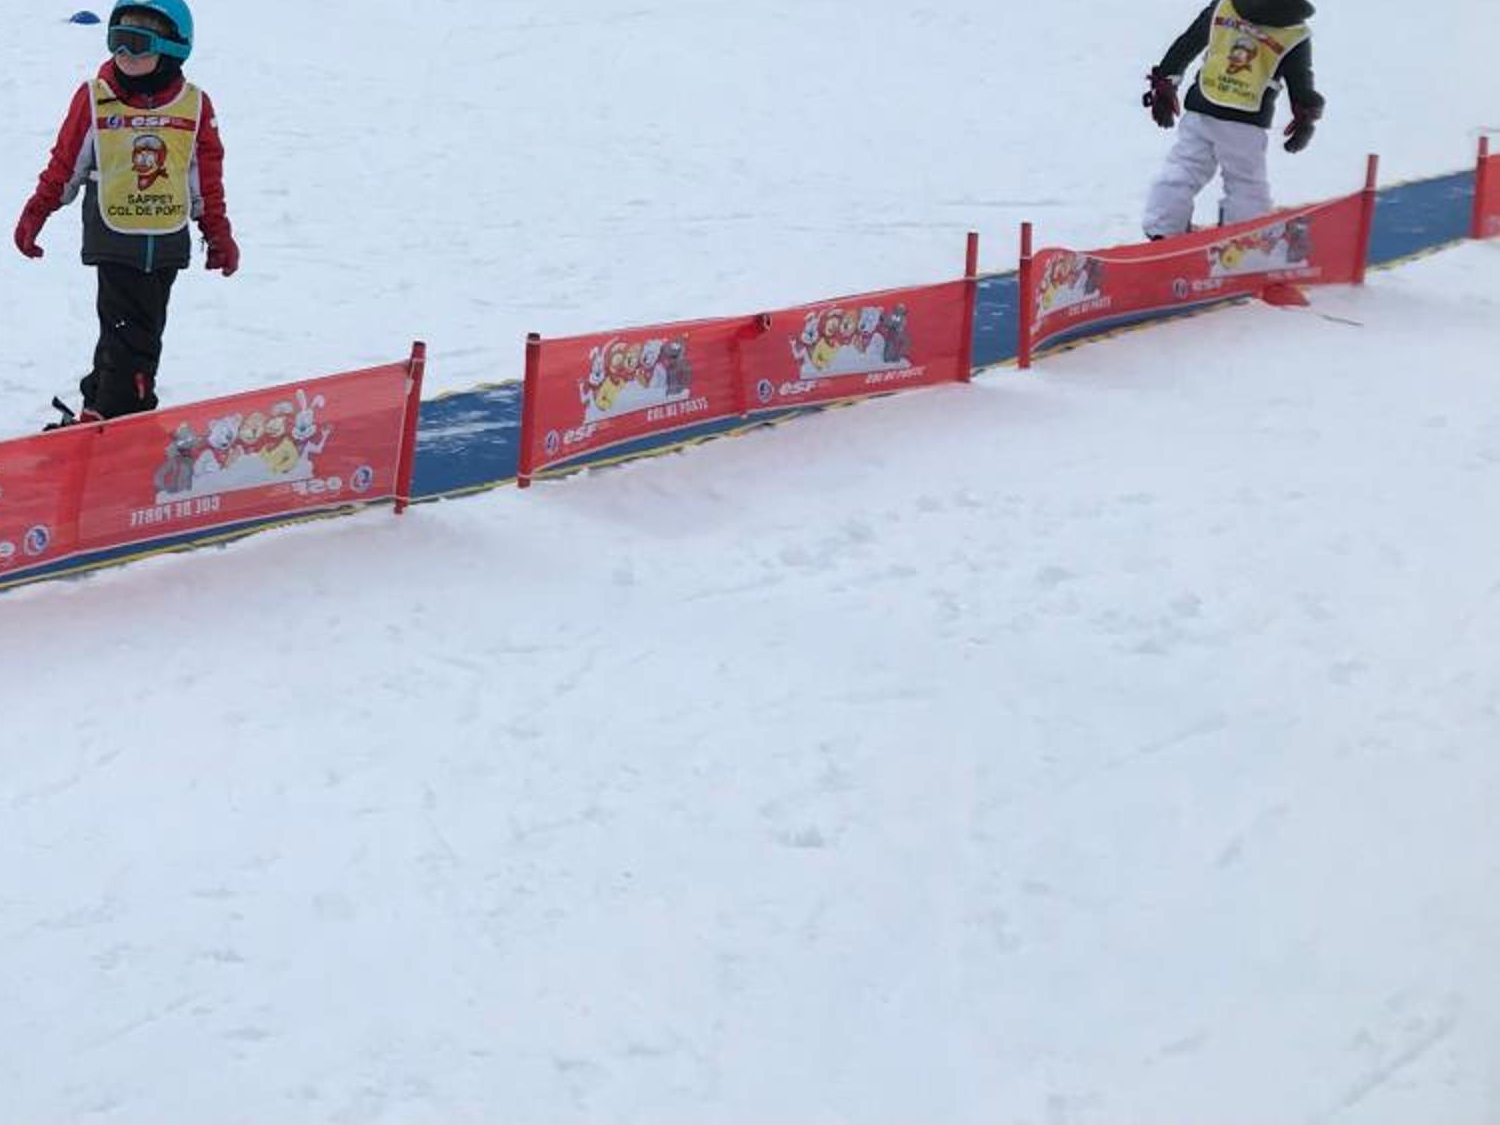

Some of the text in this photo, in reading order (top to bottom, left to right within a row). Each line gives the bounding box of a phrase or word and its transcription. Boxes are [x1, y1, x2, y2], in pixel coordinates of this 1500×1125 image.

[127, 194, 173, 204] SAPPEY
[107, 205, 132, 216] COL
[135, 205, 153, 216] DE
[779, 380, 817, 396] esf
[563, 424, 598, 444] esf
